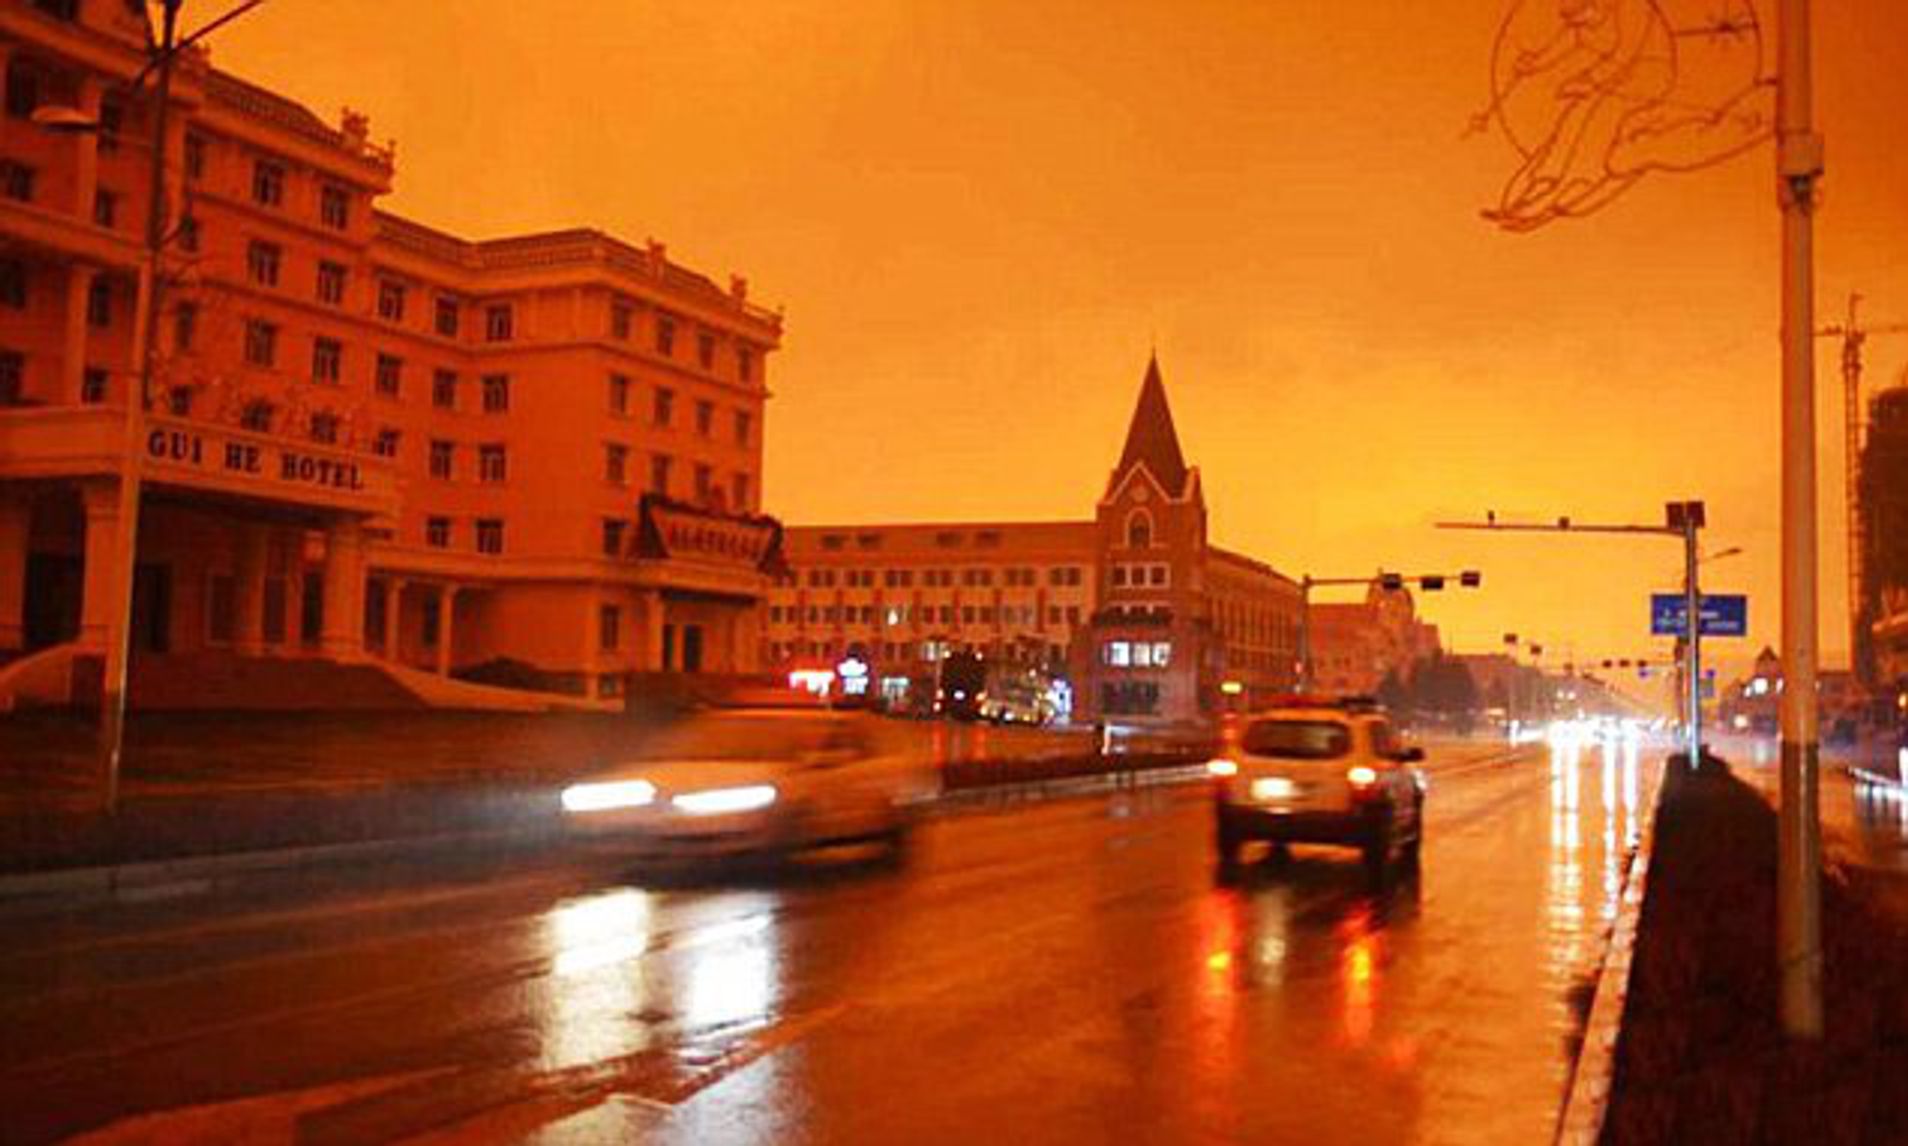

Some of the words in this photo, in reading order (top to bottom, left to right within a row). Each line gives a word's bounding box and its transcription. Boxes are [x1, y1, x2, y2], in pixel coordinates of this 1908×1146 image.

[148, 430, 202, 463] GUI
[224, 442, 262, 474] HE
[281, 453, 364, 490] HOTEL
